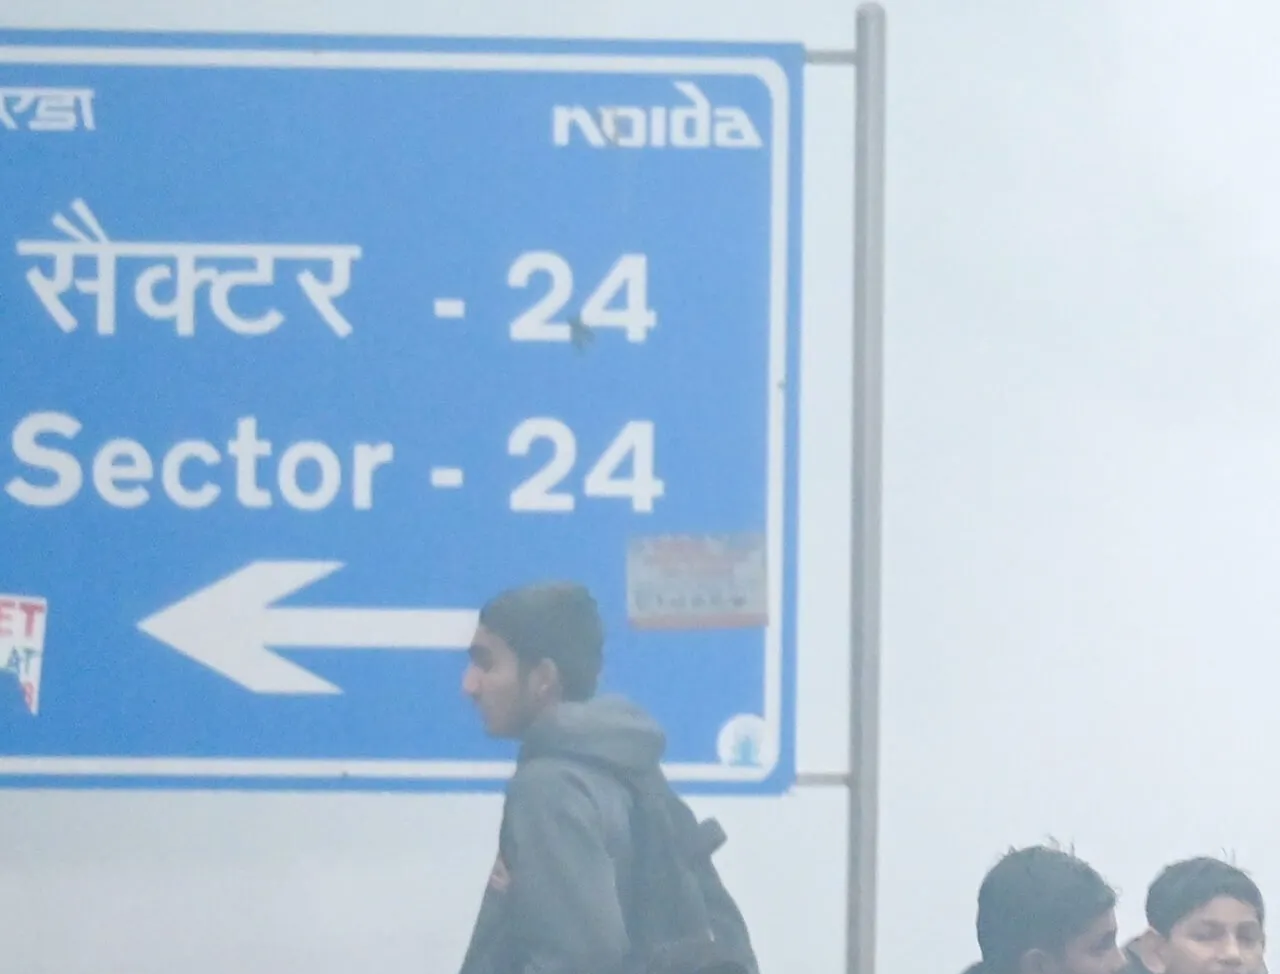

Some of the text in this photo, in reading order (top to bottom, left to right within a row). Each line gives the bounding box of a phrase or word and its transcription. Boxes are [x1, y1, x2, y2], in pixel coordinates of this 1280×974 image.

[17, 199, 362, 337] सैक्टर
[507, 251, 657, 342] 24
[6, 411, 394, 510] Sector
[507, 417, 664, 513] 24
